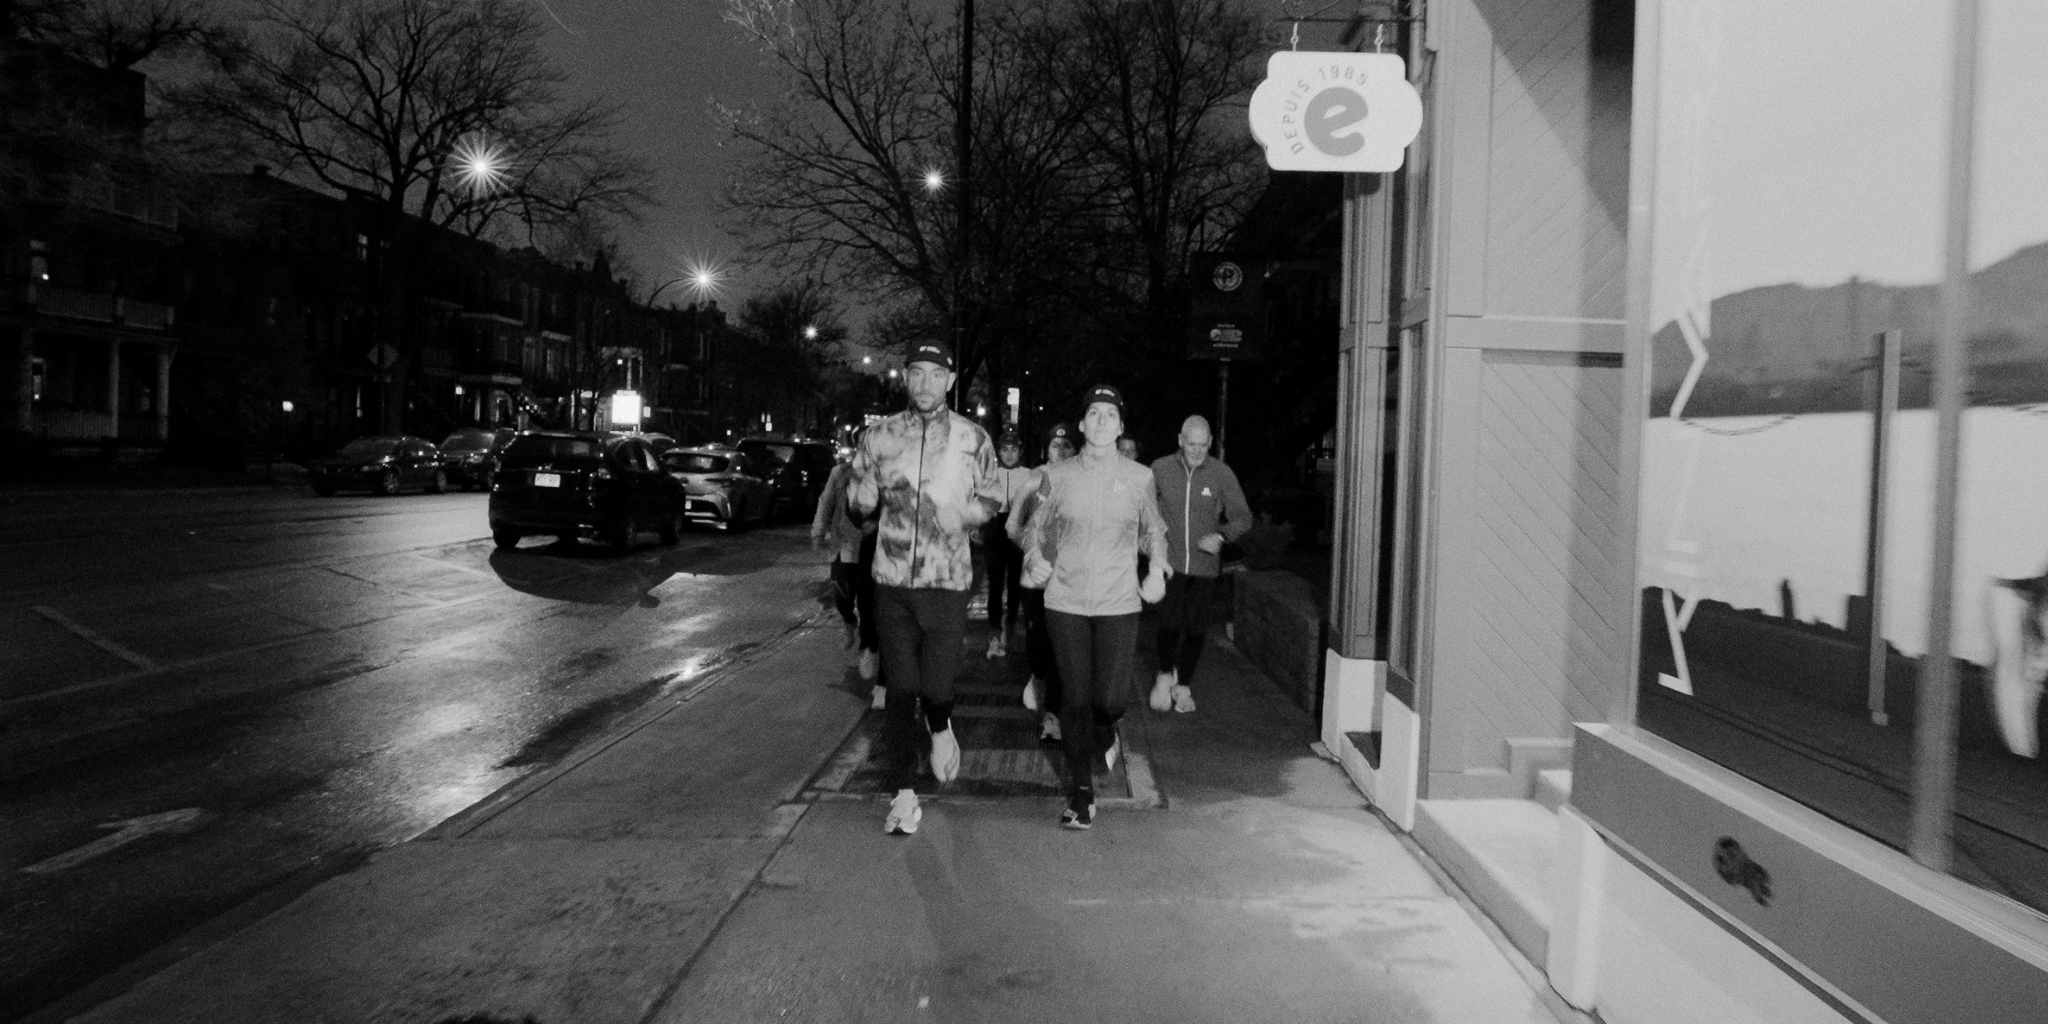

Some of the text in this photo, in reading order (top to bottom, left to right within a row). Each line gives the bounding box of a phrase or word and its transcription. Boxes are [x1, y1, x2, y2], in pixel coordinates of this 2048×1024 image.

[1282, 65, 1367, 154] DEPUIS 1985
[1304, 86, 1368, 157] e
